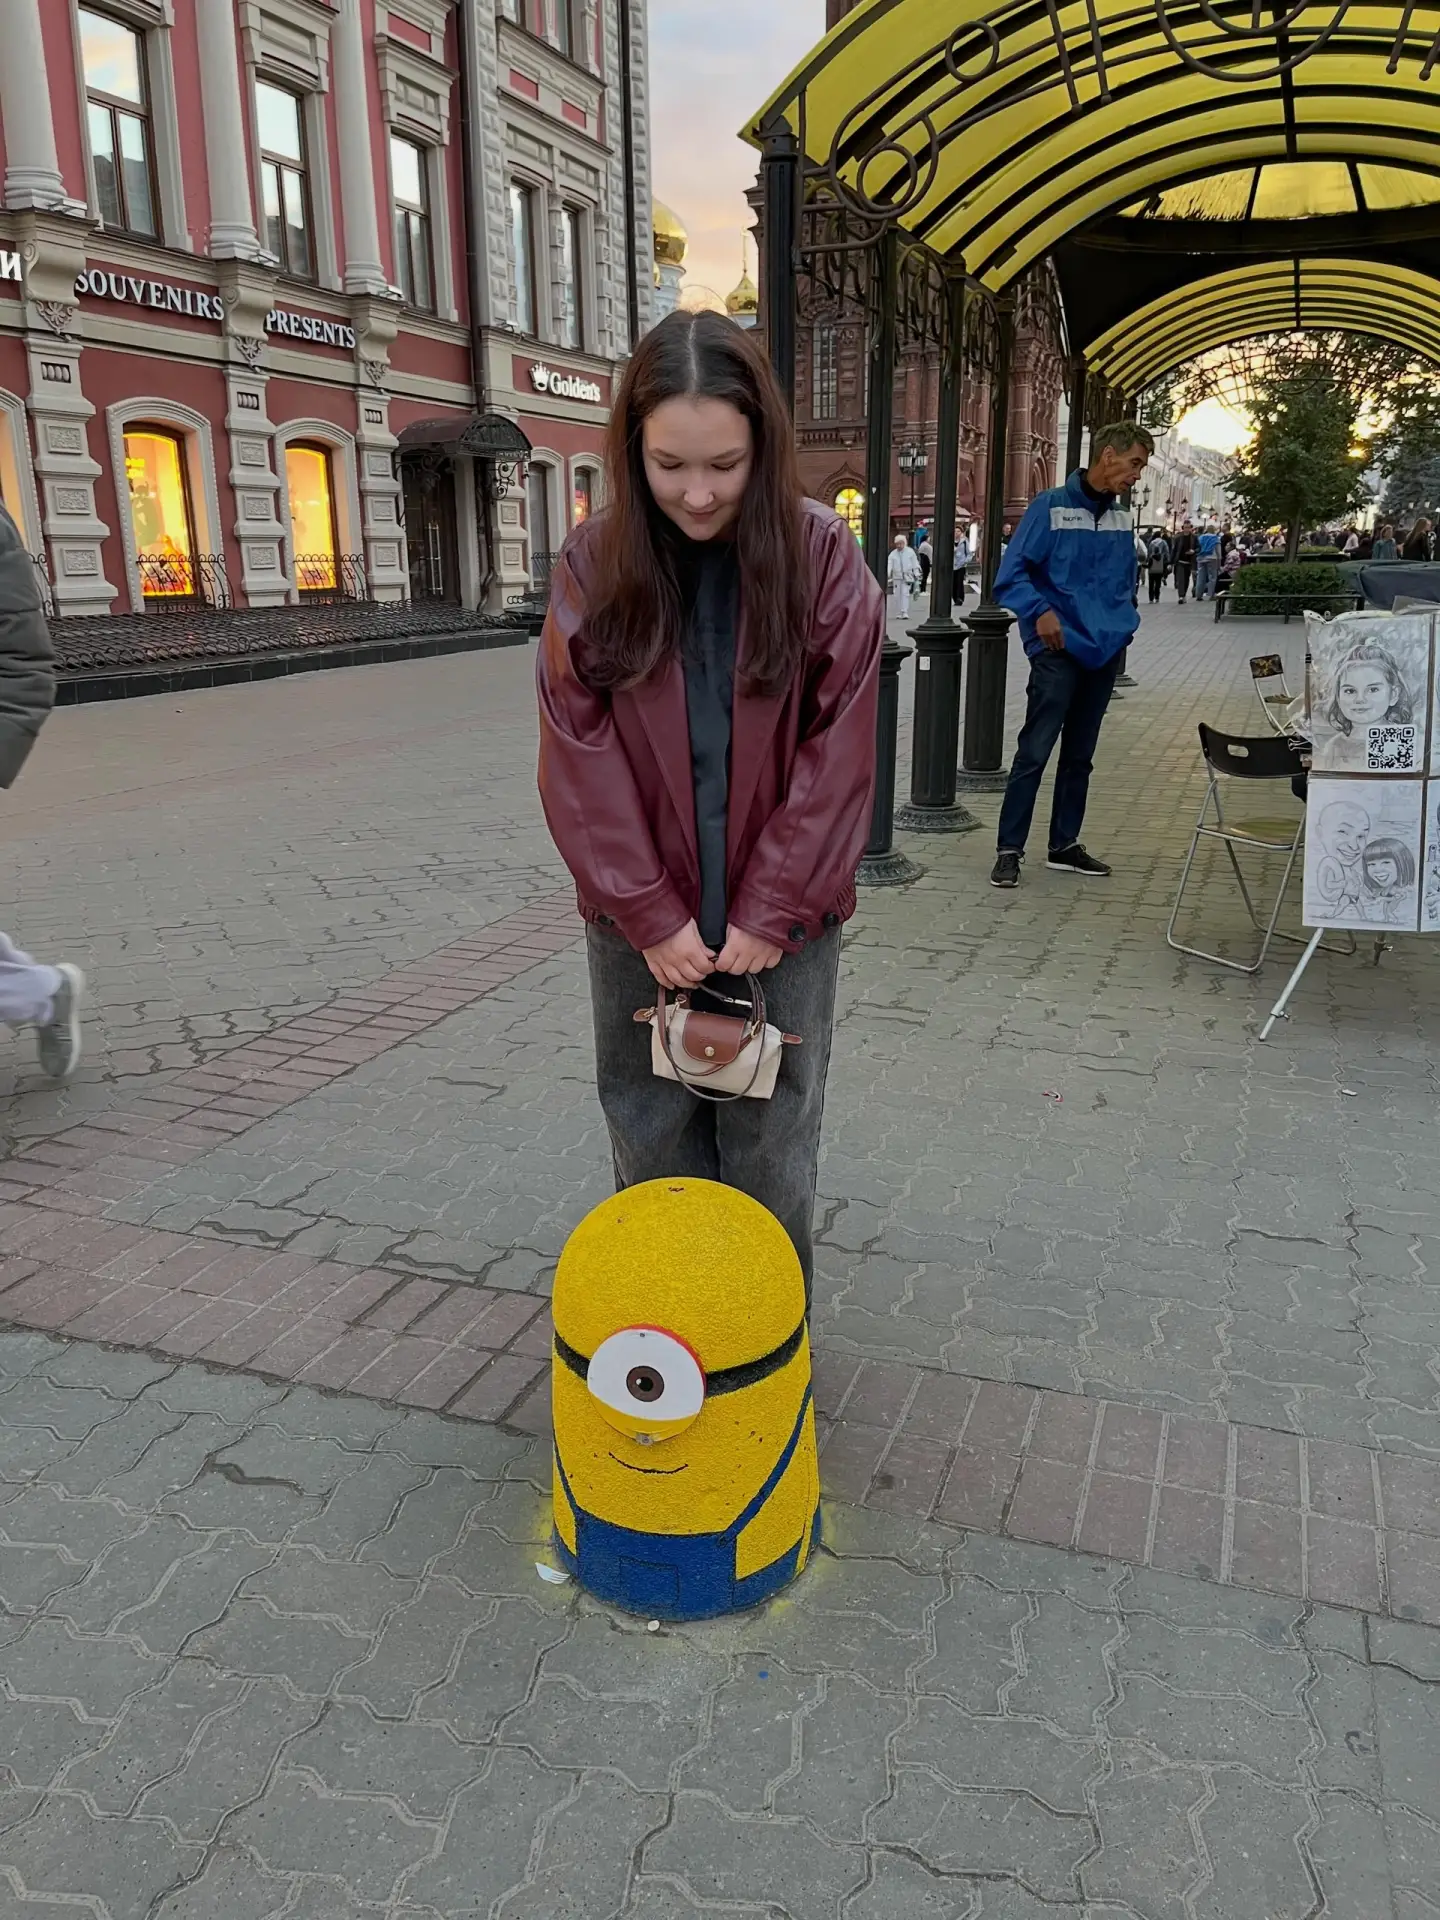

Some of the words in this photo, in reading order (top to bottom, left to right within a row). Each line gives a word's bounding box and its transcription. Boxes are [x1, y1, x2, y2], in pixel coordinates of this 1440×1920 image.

[75, 268, 224, 321] SOUVENIRS
[266, 309, 356, 349] PRESENTS
[549, 371, 601, 402] Golden's
